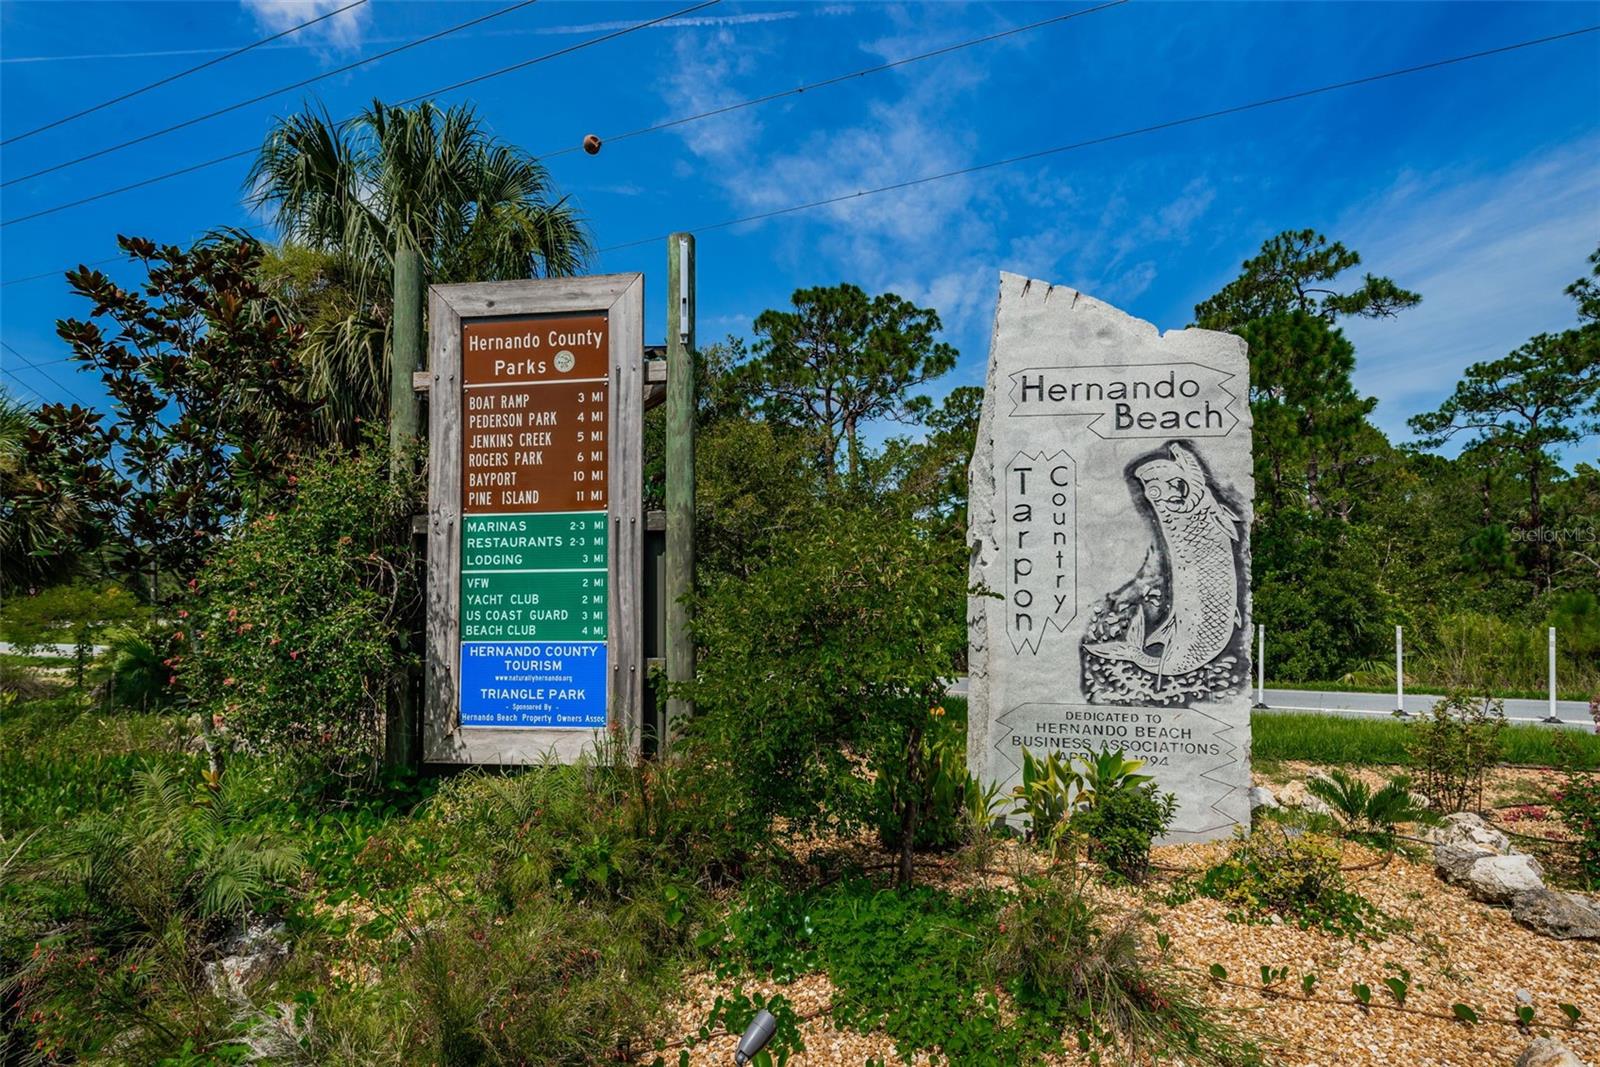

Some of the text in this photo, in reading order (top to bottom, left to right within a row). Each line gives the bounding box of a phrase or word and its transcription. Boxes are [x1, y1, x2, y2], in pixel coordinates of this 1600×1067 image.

[470, 330, 602, 351] Hernando County
[495, 359, 546, 375] Parks
[1022, 371, 1200, 402] Hernando
[470, 392, 603, 410] BOAT RAMP 3 MI
[470, 412, 603, 428] PEDERSON PARK 4 MI
[1115, 401, 1222, 430] Beach
[470, 431, 602, 449] JENKINS CREEK 5 MI
[469, 451, 602, 467] ROGERS PARK 6 MI
[470, 470, 603, 487] BAYPORT 10 MI
[469, 490, 602, 505] PINE ISLAND 11 MI
[468, 521, 527, 532] MARINAS
[594, 520, 603, 529] MI
[468, 536, 562, 548] RESTAURANTS
[594, 537, 603, 545] MI
[1050, 466, 1068, 614] Country
[1013, 467, 1033, 631] Tarpon
[467, 554, 603, 565] LODGING 3 MI
[467, 578, 603, 588] VFW 2 MI
[467, 594, 503, 605] YACHT
[511, 594, 539, 605] CLUB
[582, 596, 588, 604] 2
[466, 610, 602, 620] US COAST GUARD 3 MI
[466, 625, 603, 635] BEACH CLUB 4 MI
[470, 646, 598, 657] HERNANDO COUNTY
[505, 661, 562, 671] TOURISM
[481, 689, 585, 699] TRIANGLE PARK
[522, 714, 552, 723] Property
[1066, 711, 1161, 723] DEDICATED TO
[1036, 723, 1191, 739] HERNANDO BEACH
[1012, 735, 1219, 755] BUSINESS ASSOCIATIONS
[1059, 752, 1099, 763] APRI
